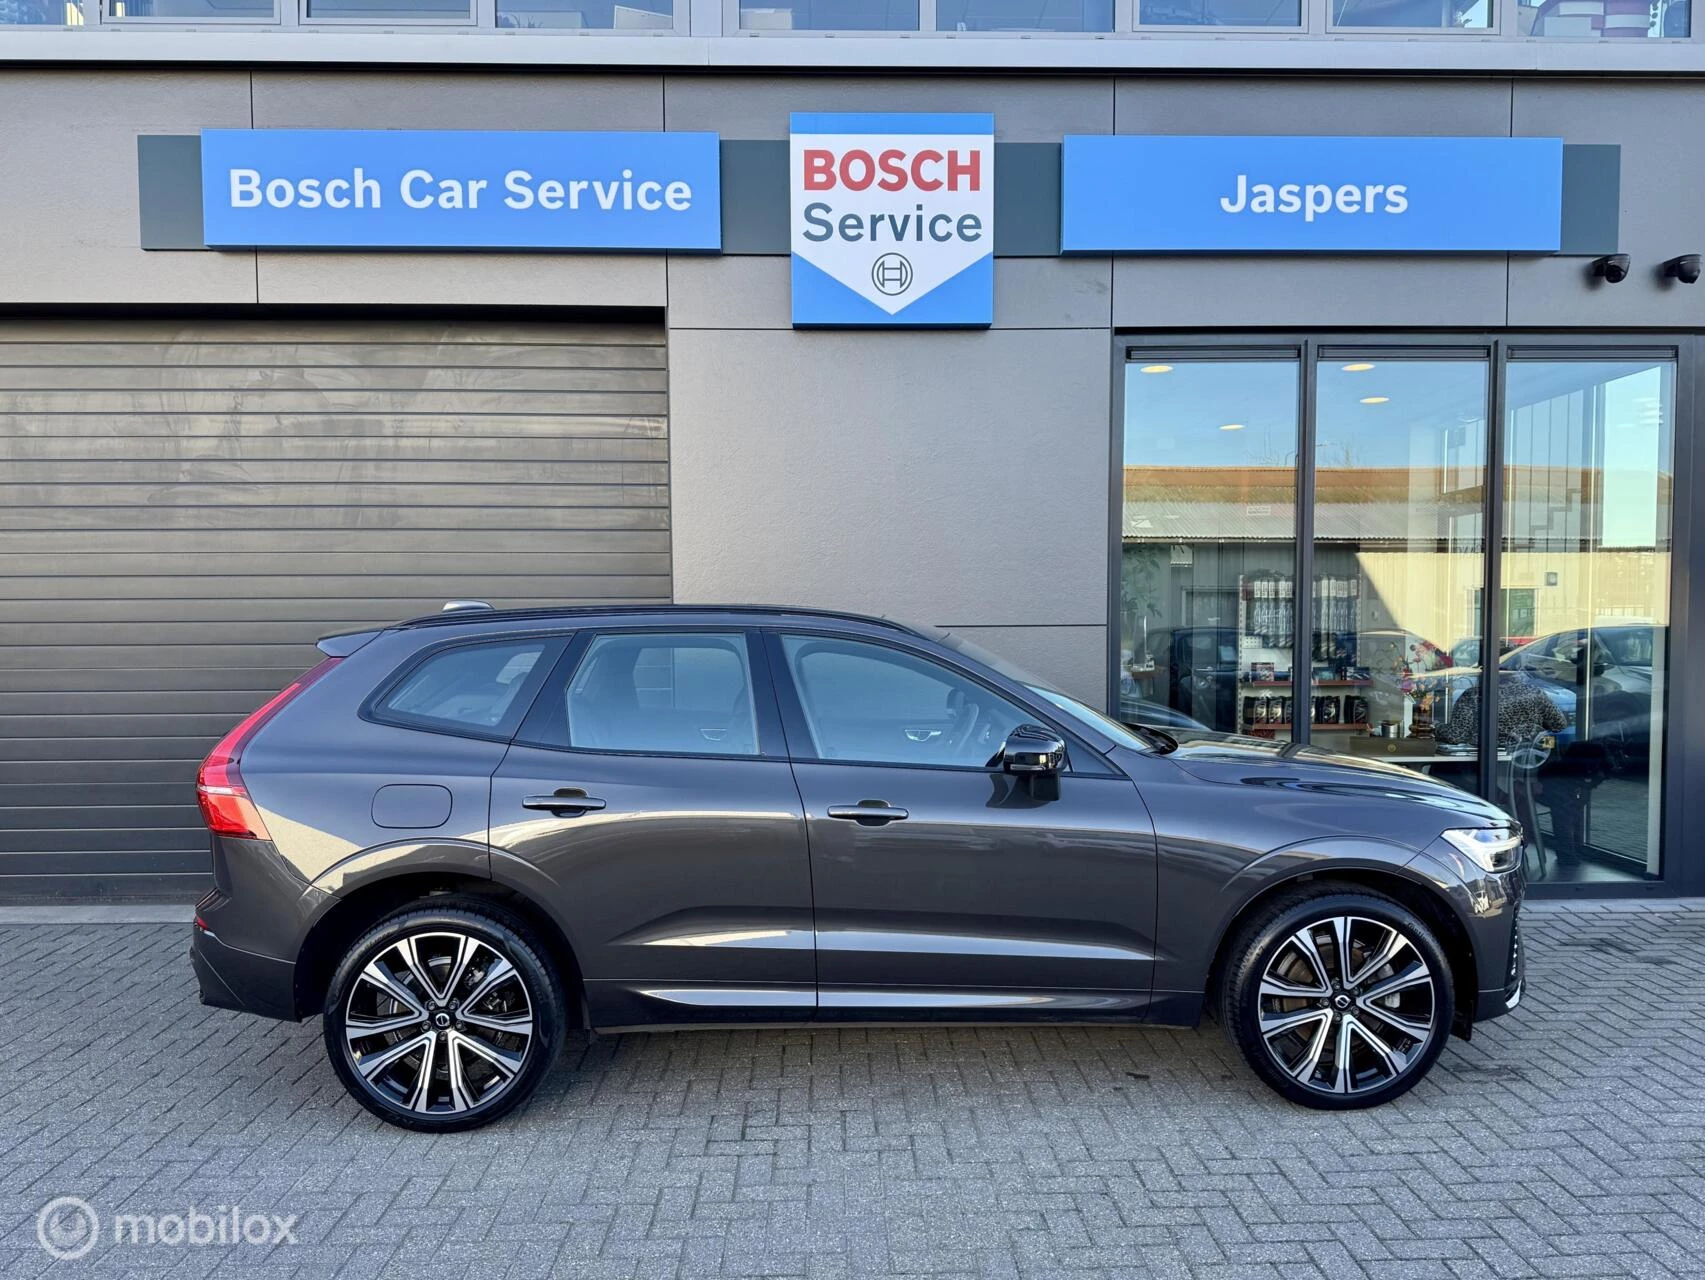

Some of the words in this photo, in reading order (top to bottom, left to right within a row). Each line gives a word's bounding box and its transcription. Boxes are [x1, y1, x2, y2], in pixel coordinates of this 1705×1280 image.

[230, 168, 381, 209] Bosch
[400, 169, 487, 209] Car
[504, 169, 692, 211] Service
[803, 149, 981, 192] BOSCH
[1220, 174, 1409, 223] Jaspers
[802, 202, 982, 242] Service
